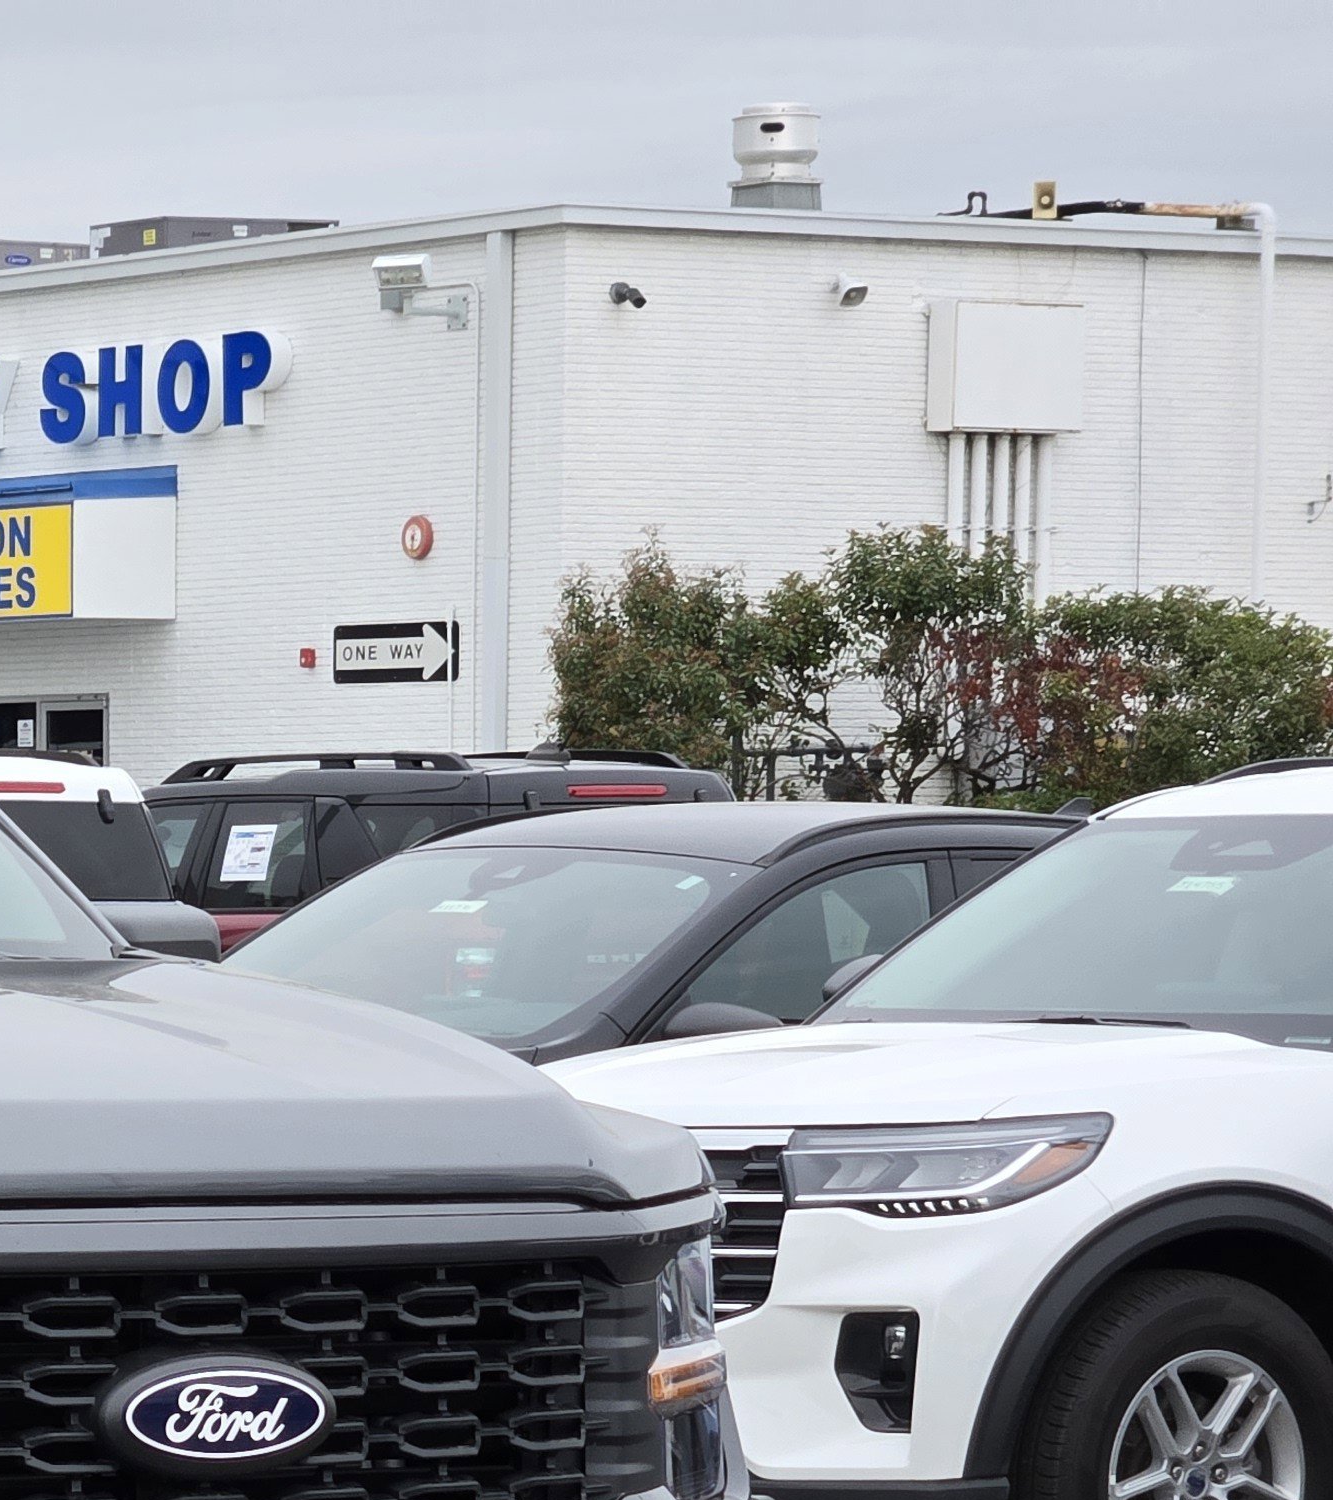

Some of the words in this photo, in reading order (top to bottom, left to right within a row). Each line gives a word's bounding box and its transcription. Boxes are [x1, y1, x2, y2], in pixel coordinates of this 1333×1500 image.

[40, 331, 274, 445] SHOP
[343, 646, 377, 661] ONE
[389, 643, 423, 660] WAY
[165, 1384, 288, 1443] Ford
